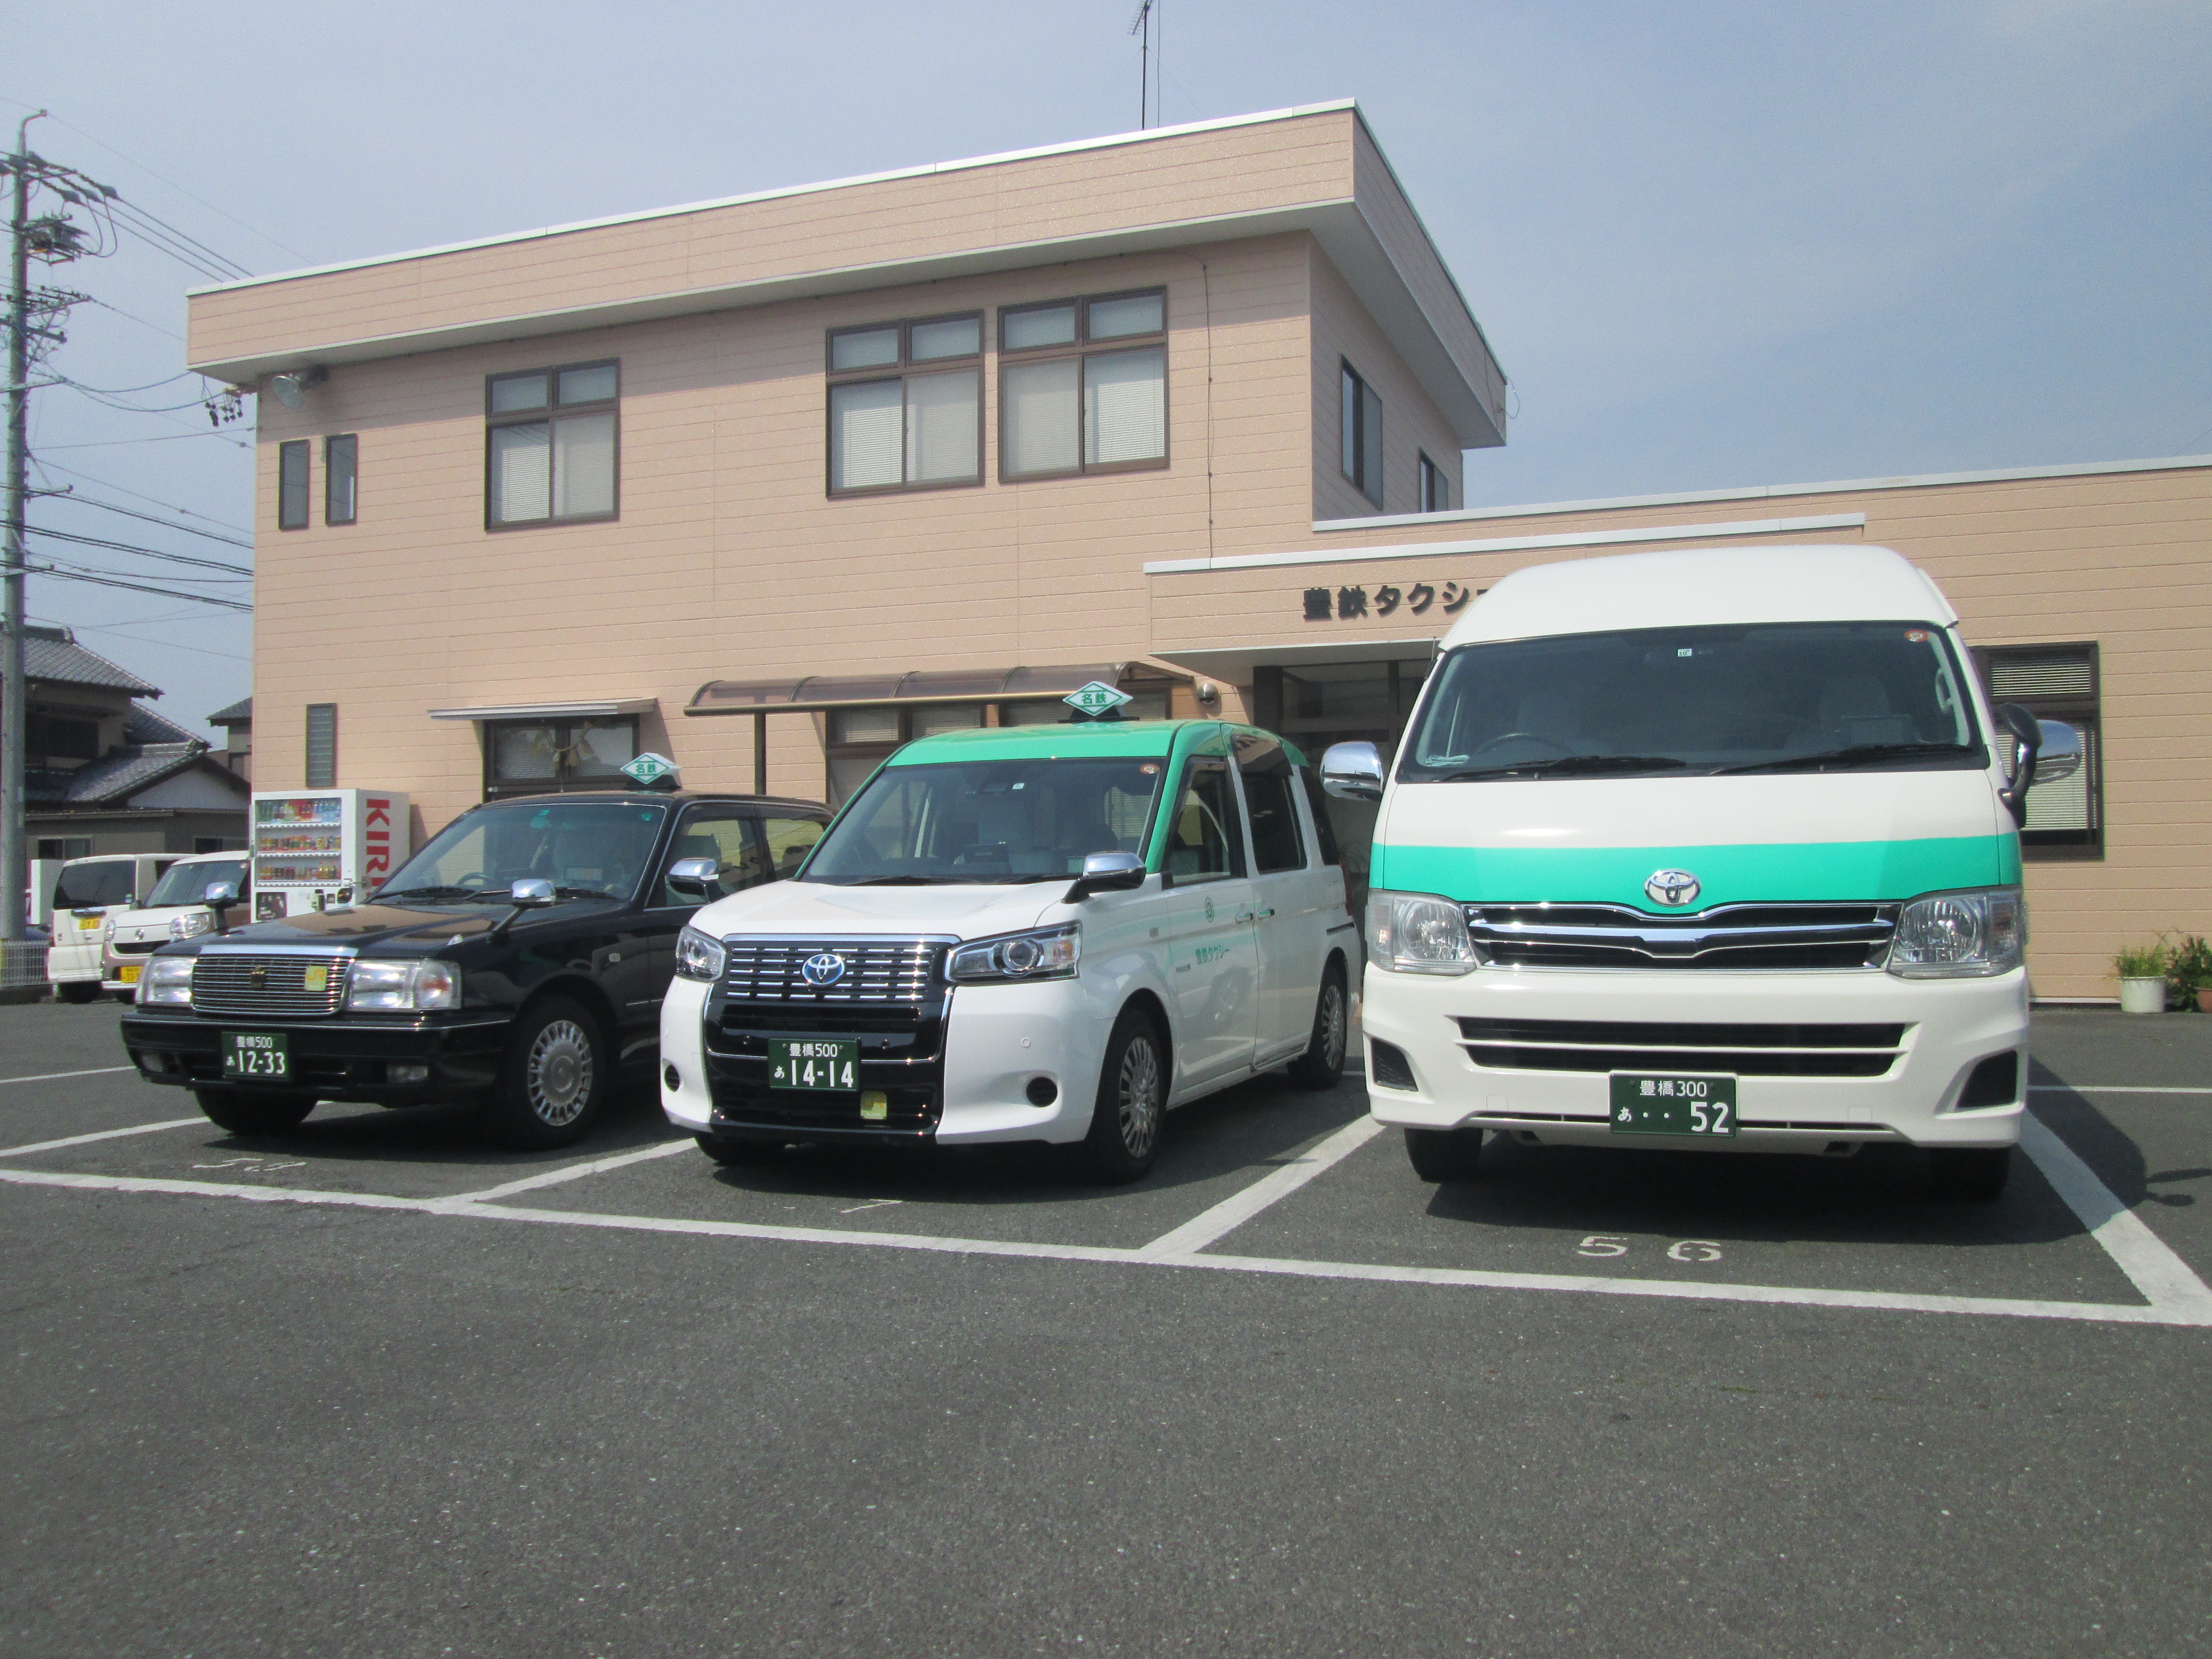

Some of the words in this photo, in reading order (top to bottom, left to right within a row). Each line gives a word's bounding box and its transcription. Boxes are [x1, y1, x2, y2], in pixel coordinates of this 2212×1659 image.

[1082, 692, 1106, 704] 名鉄
[366, 799, 390, 899] KIRI
[307, 969, 325, 981] JR
[239, 1050, 286, 1074] 12-33
[774, 1065, 785, 1079] あ
[792, 1059, 854, 1088] 14-14
